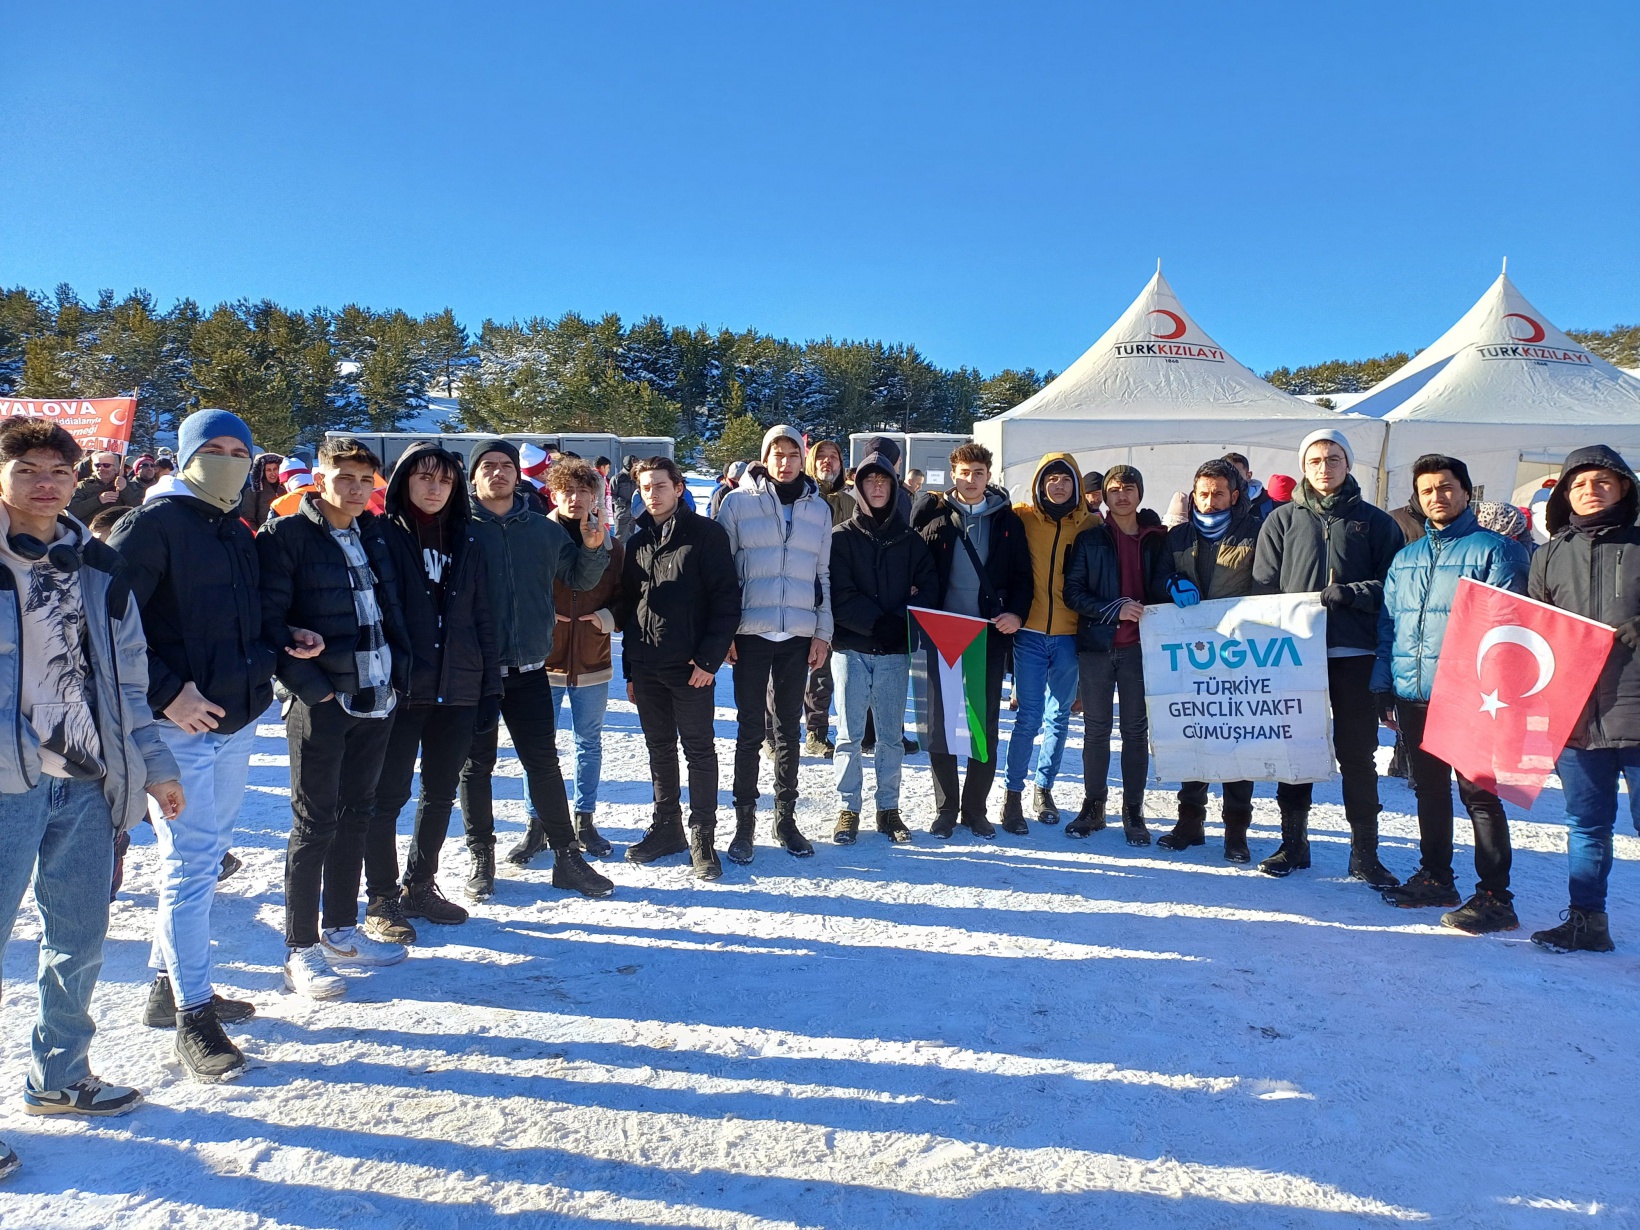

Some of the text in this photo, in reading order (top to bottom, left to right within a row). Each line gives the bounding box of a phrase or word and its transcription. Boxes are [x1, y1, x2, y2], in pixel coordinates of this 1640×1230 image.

[0, 401, 97, 417] YALOVA
[1193, 675, 1271, 696] TÜRKİYE
[1168, 697, 1303, 718] GENÇLİK VAKFI
[1182, 722, 1293, 743] GÜMÜŞHANE
